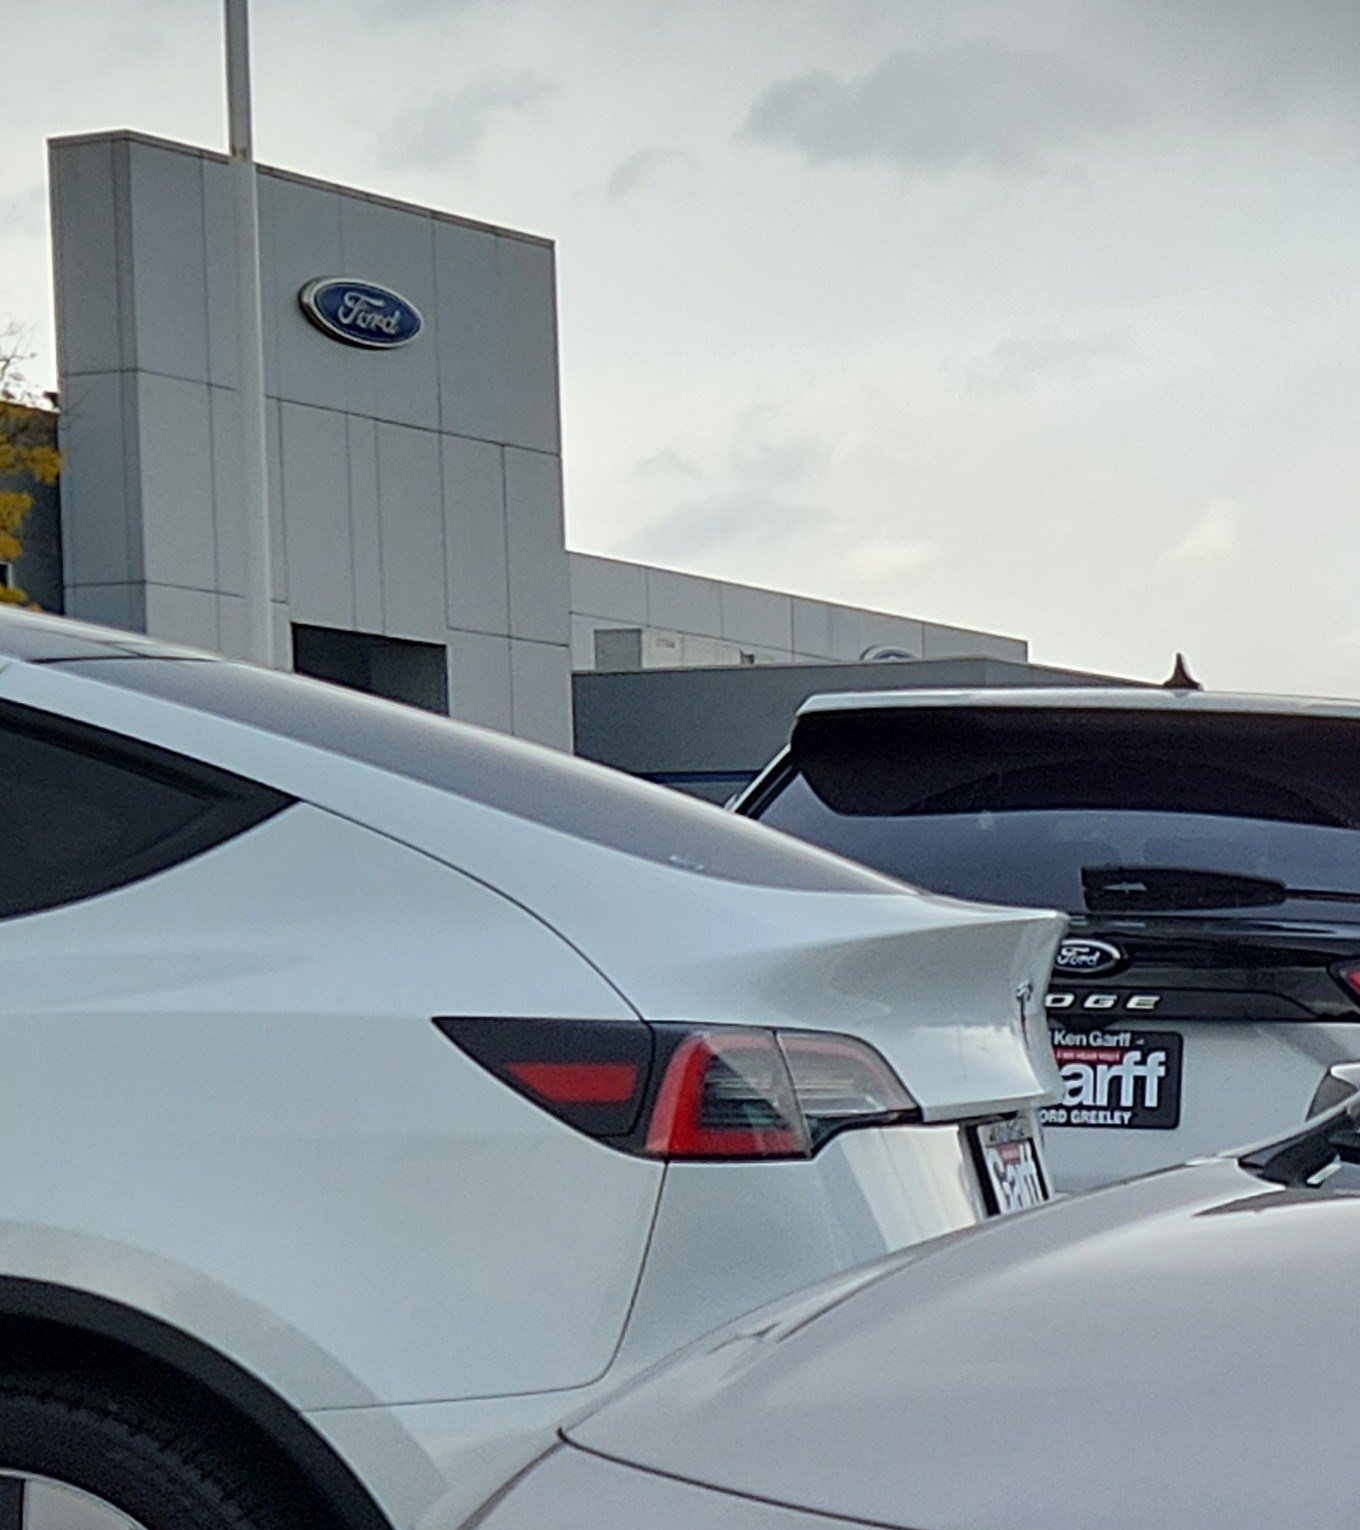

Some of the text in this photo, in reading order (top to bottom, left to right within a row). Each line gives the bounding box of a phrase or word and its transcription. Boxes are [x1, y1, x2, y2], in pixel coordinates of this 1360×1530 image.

[338, 291, 400, 334] Ford
[1057, 947, 1100, 966] Ford
[1045, 994, 1160, 1010] DGE
[1053, 1030, 1131, 1047] Ken Garff
[1060, 1050, 1166, 1107] arff
[1040, 1109, 1132, 1124] ORD GREELEY
